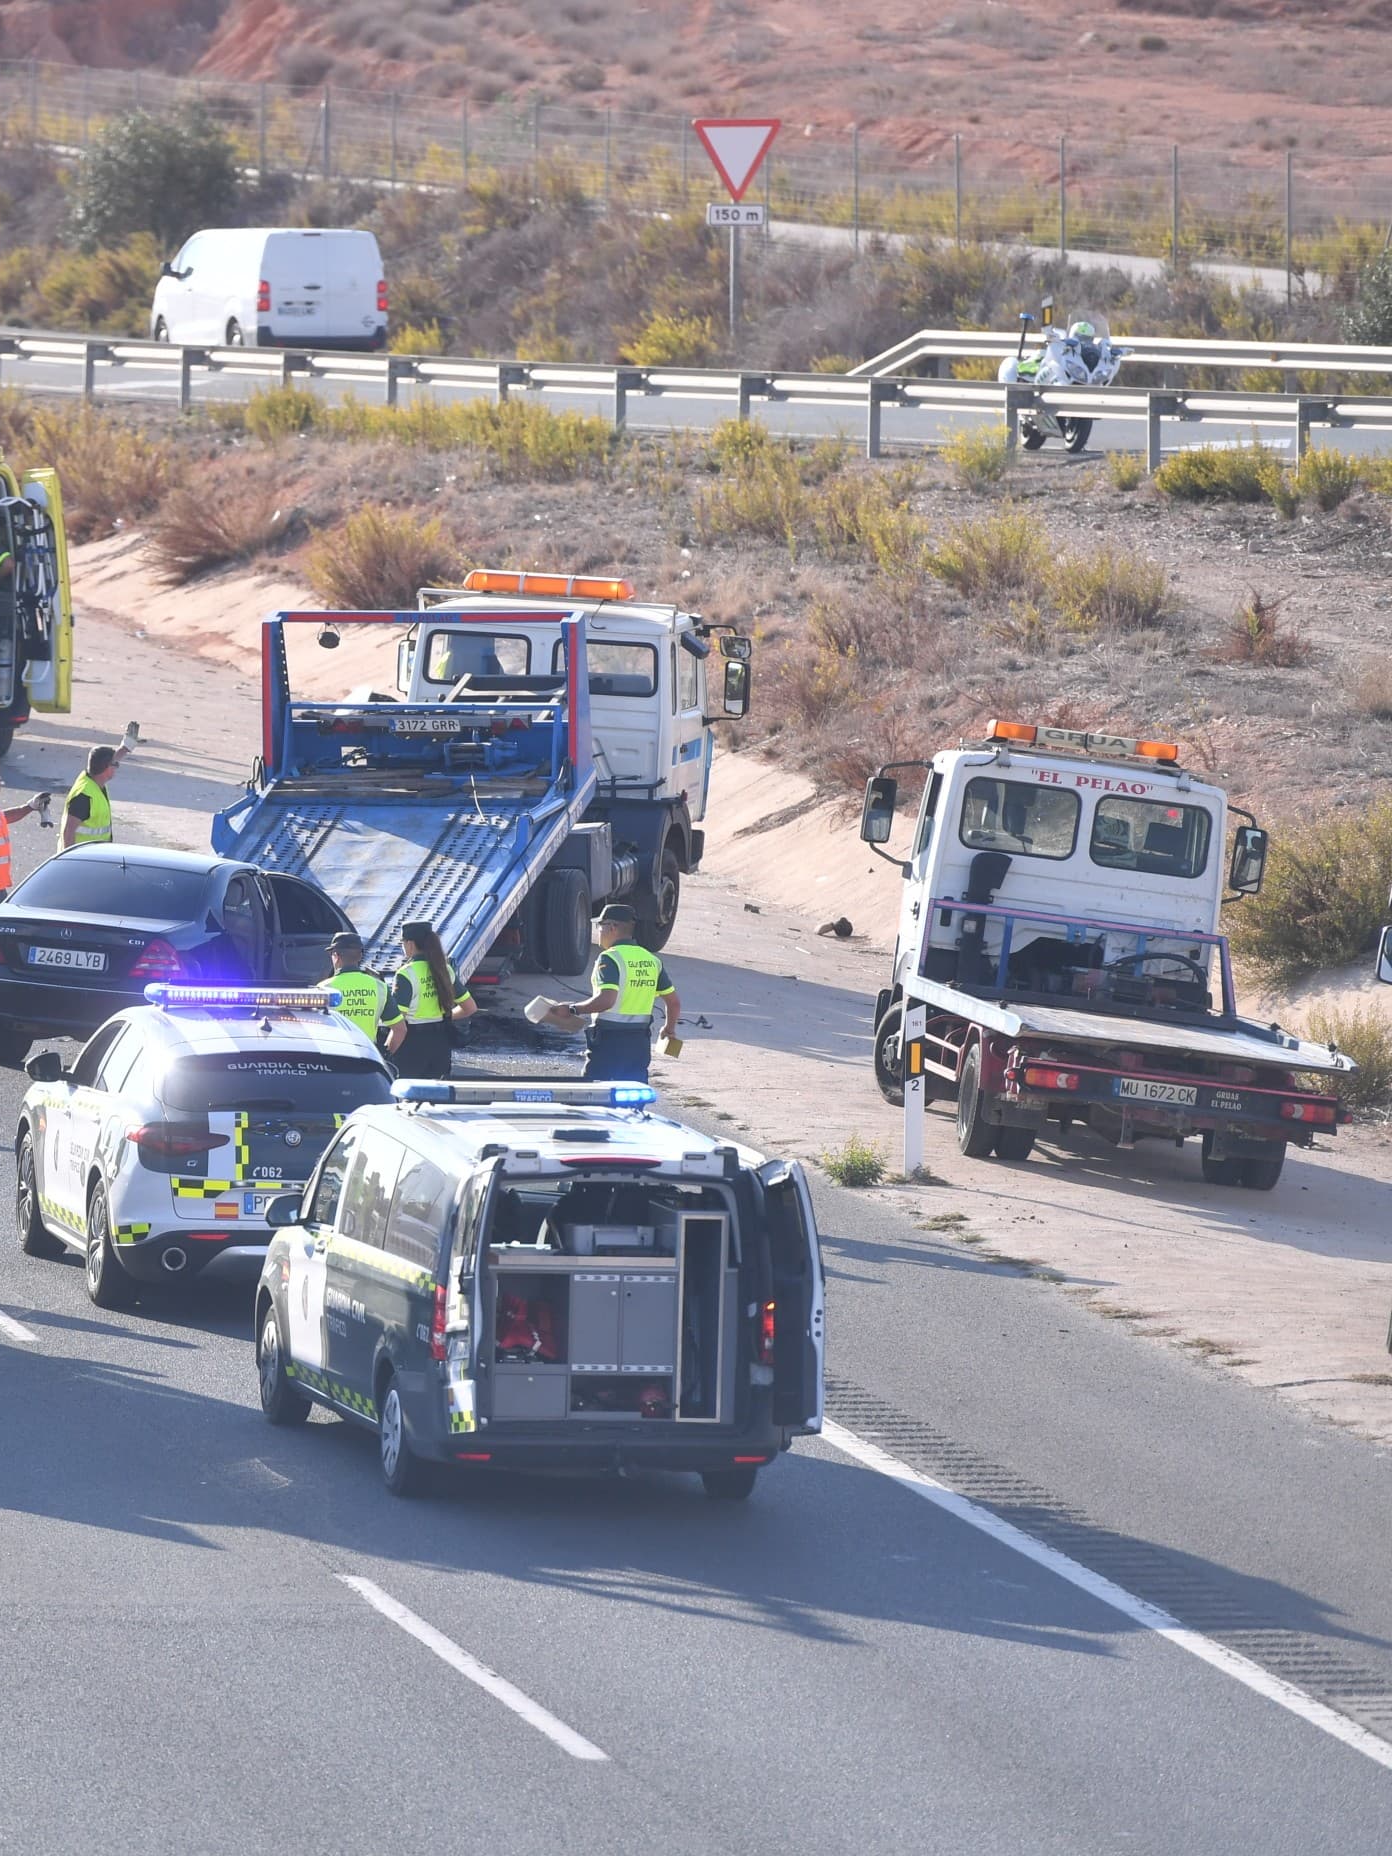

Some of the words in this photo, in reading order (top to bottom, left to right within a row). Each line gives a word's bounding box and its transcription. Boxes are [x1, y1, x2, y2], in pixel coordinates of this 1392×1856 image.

[715, 209, 740, 221] 150
[746, 211, 759, 221] m
[398, 720, 427, 731] 3172
[432, 719, 457, 731] GRR
[1044, 729, 1127, 748] GRUA
[37, 951, 72, 965] 2469
[75, 954, 101, 968] LYB
[227, 1062, 293, 1070] GUARDIA
[297, 1063, 333, 1072] CIVIL
[911, 1080, 920, 1091] 2
[1120, 1081, 1139, 1096] MU
[1143, 1084, 1176, 1101] 1672
[1177, 1088, 1196, 1103] CK
[1215, 1090, 1240, 1100] GRUAS
[1210, 1100, 1220, 1108] EL
[1220, 1101, 1242, 1111] PELAO
[261, 1166, 283, 1178] 062
[327, 1287, 351, 1317] GUARDIA
[352, 1299, 366, 1325] CIVIL
